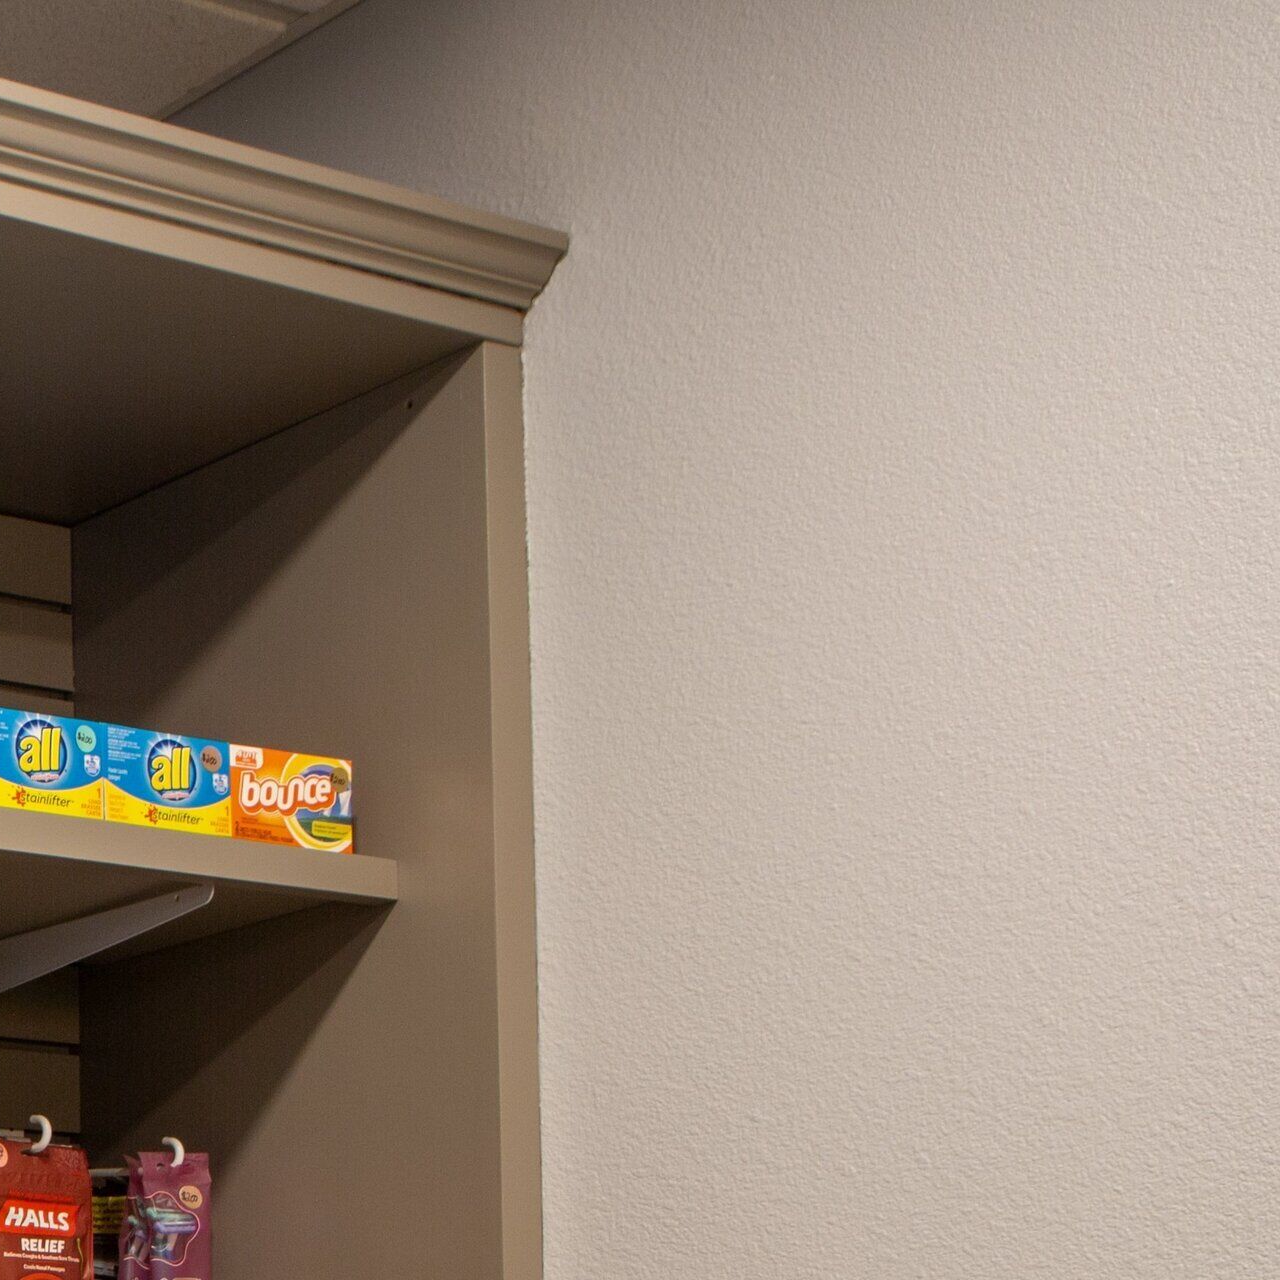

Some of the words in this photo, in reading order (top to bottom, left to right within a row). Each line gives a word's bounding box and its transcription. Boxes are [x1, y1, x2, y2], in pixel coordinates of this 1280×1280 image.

[19, 727, 62, 773] all
[149, 745, 191, 792] all
[20, 793, 70, 808] stainlifter
[242, 772, 332, 810] bounce
[150, 809, 201, 827] stainlifter
[5, 1207, 70, 1231] HALLS
[21, 1238, 65, 1253] RELIEF
